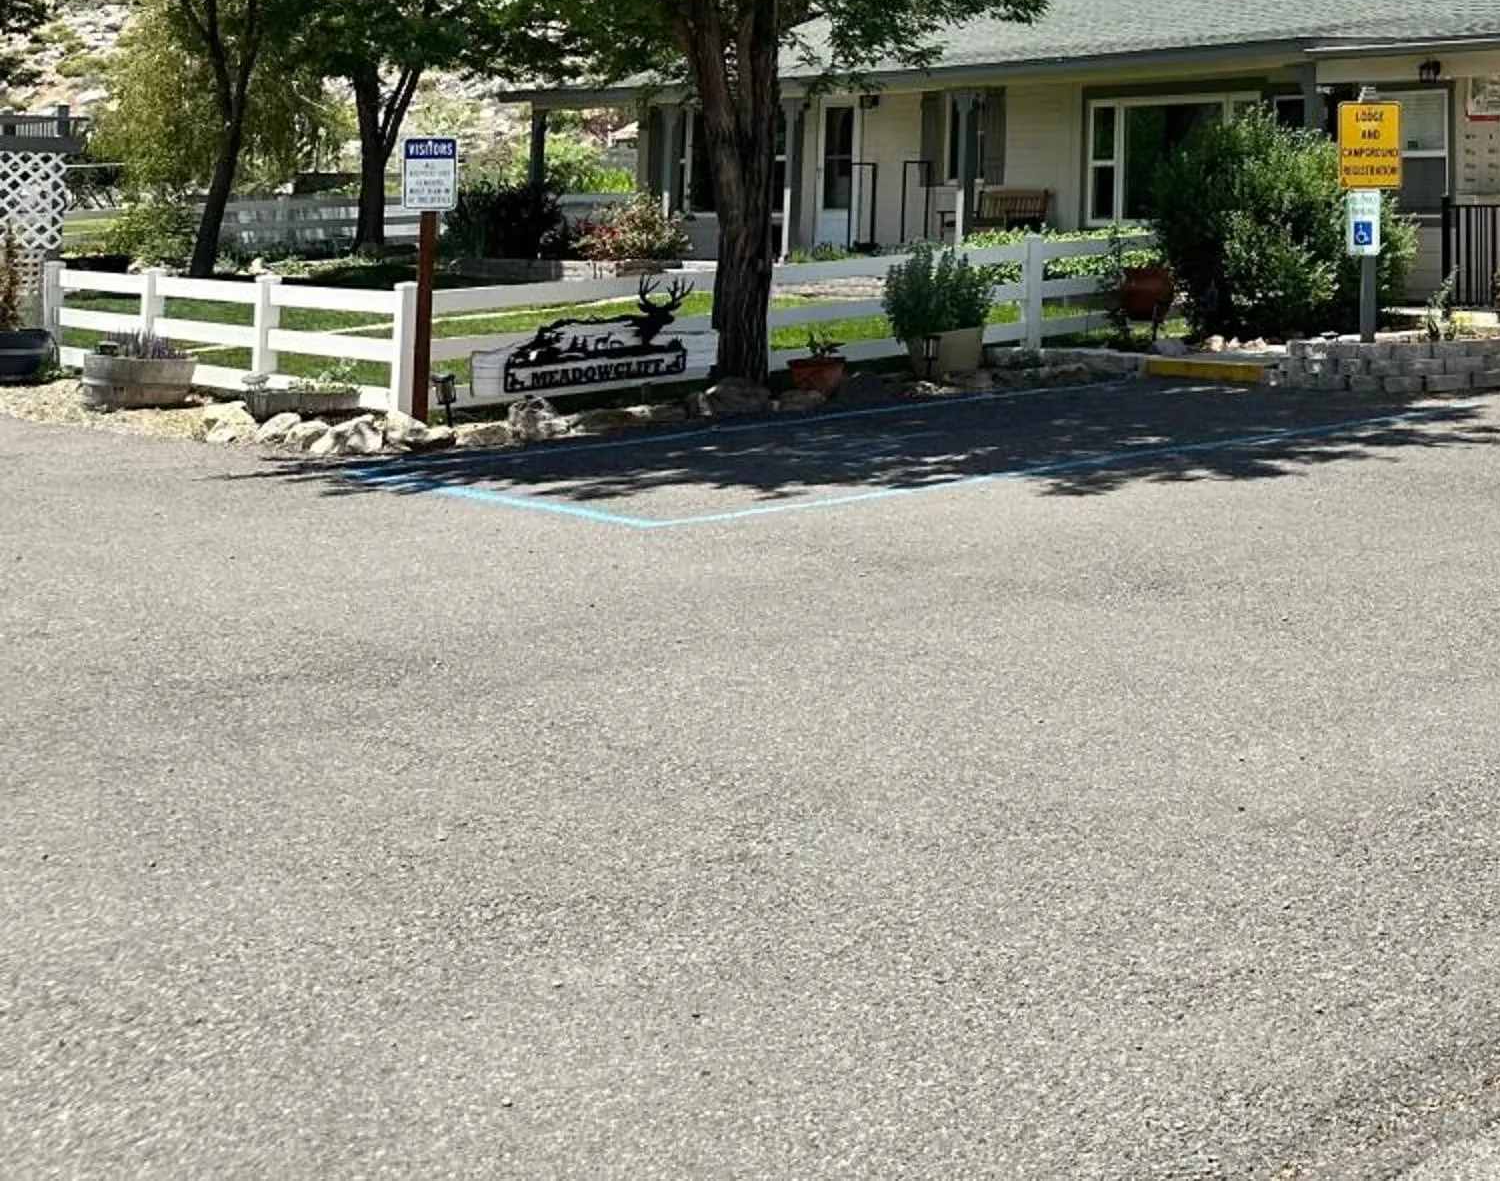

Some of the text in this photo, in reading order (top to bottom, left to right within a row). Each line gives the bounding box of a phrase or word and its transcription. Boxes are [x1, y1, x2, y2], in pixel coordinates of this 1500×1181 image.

[1355, 110, 1384, 122] LODGE
[1361, 129, 1380, 139] AND
[408, 140, 453, 156] VISITORS
[1342, 146, 1398, 157] CAMPGROUND
[1343, 165, 1397, 175] REGISTRATION
[531, 359, 665, 389] MEADOWCLIFF
